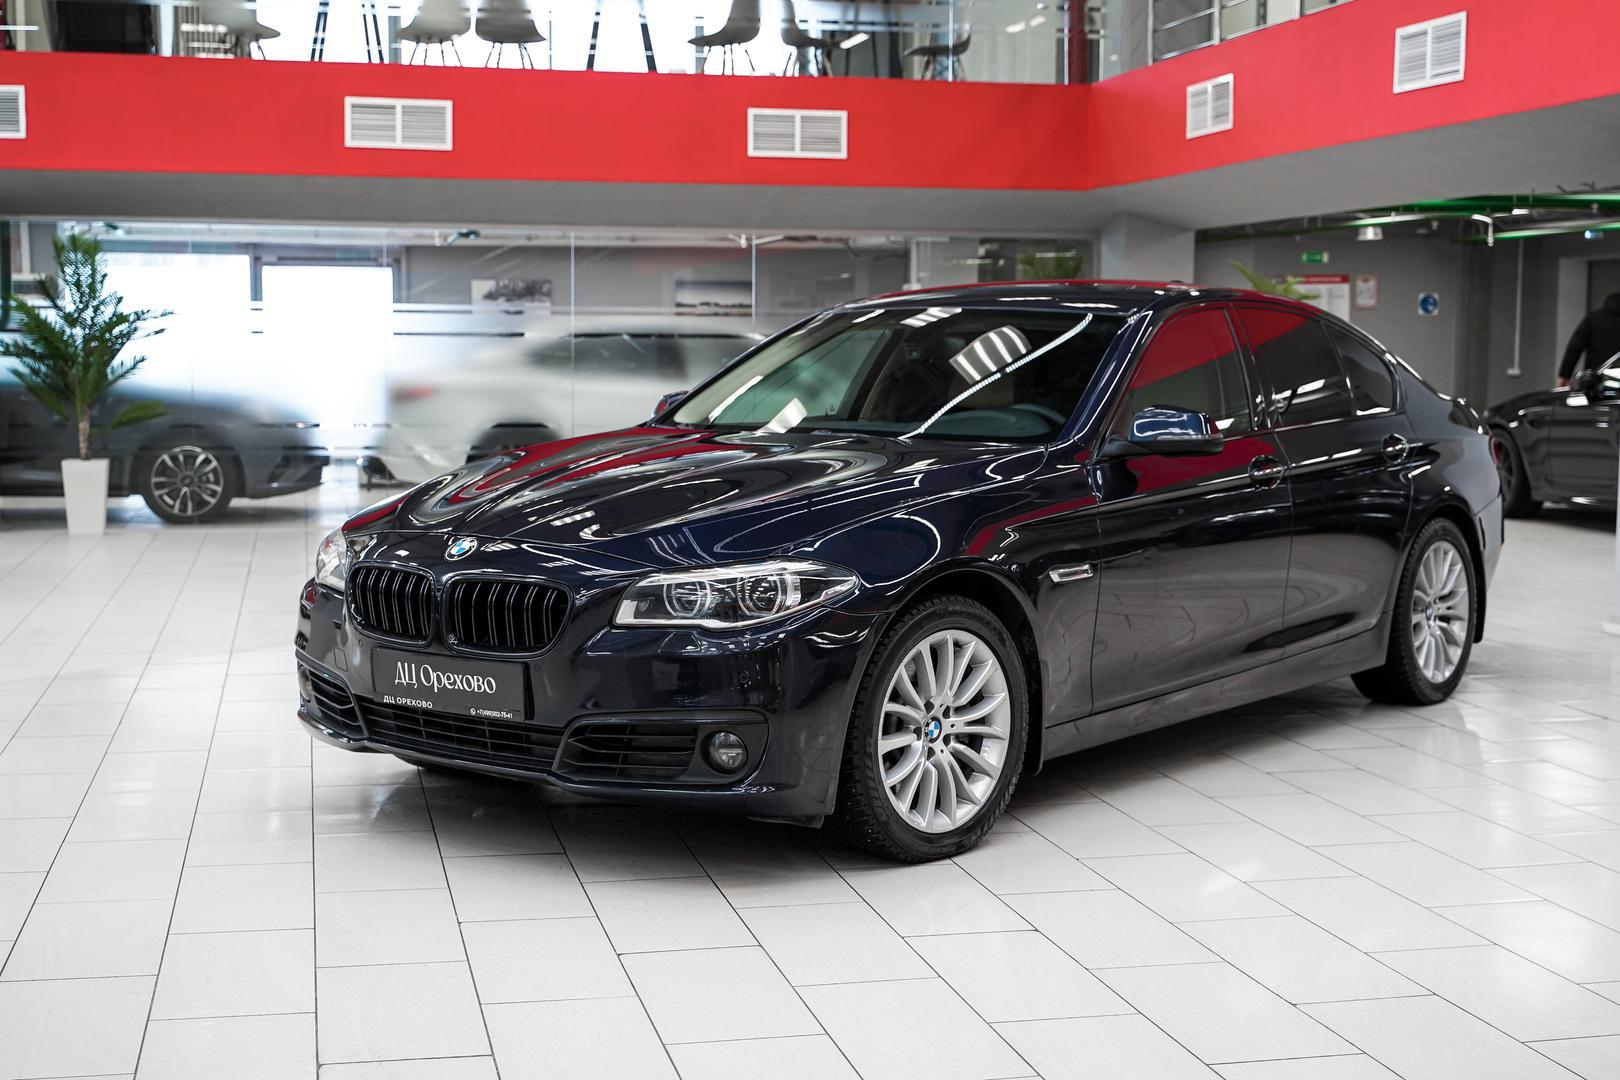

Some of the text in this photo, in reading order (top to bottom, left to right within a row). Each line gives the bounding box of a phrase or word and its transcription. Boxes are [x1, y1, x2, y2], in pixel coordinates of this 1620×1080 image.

[395, 661, 496, 694] ДЦ Орехово
[383, 695, 433, 709] ДЦ ОРЕХОВО
